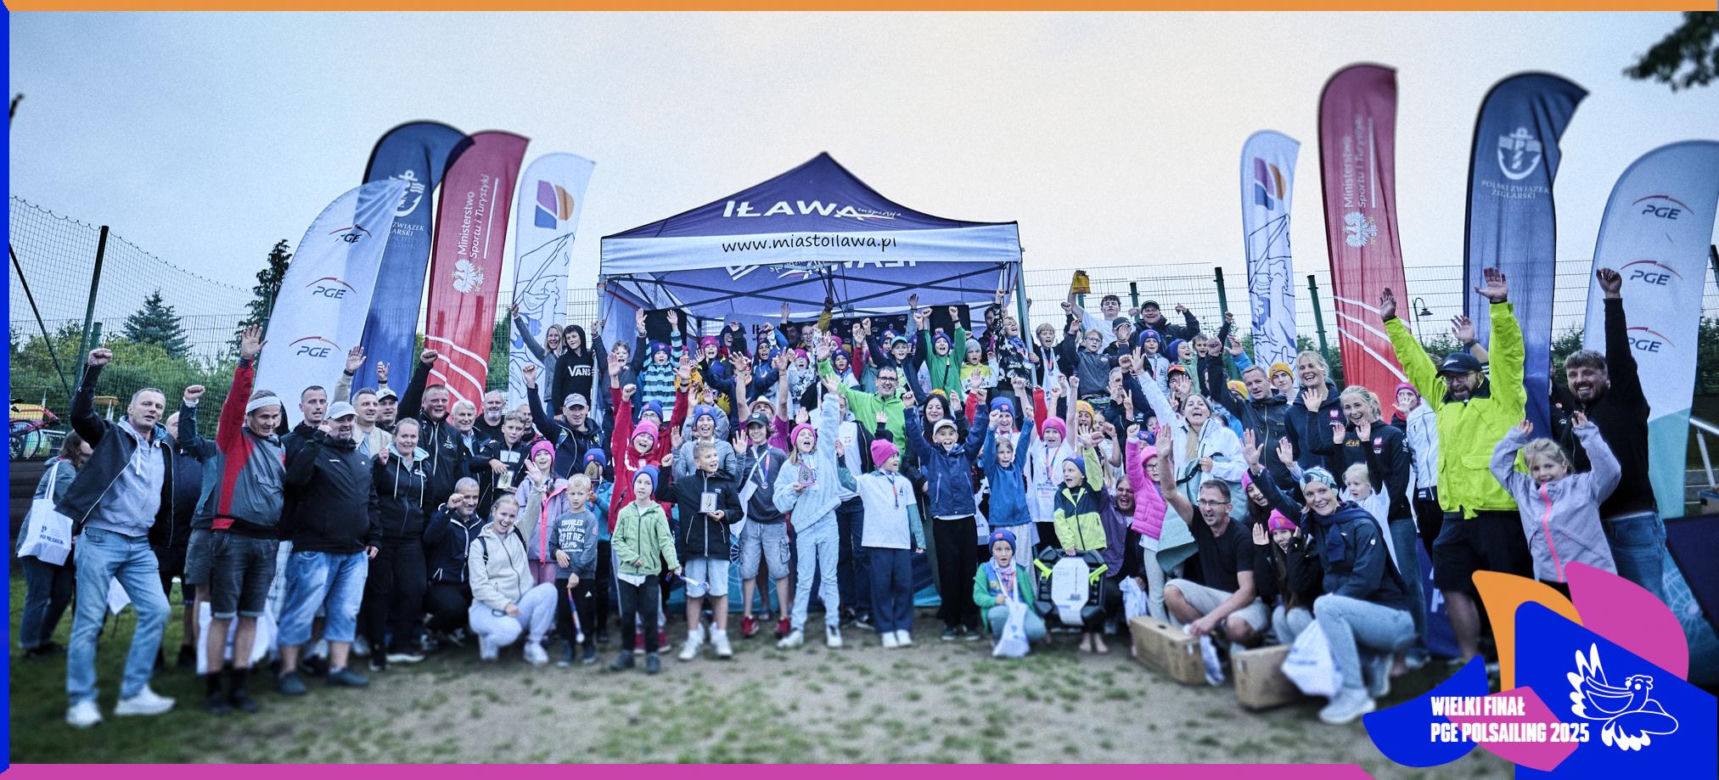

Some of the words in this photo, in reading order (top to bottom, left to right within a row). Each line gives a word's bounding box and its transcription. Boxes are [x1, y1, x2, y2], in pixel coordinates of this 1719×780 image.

[475, 173, 490, 216] Turystyki
[723, 200, 864, 221] IŁAWA
[1642, 204, 1681, 220] PGE
[457, 191, 475, 256] Ministerstwo
[469, 225, 482, 259] Sportu
[722, 234, 897, 253] www.miastoilawa.pl
[1630, 270, 1671, 286] PGE
[312, 285, 347, 299] PGE
[296, 345, 331, 358] PGE
